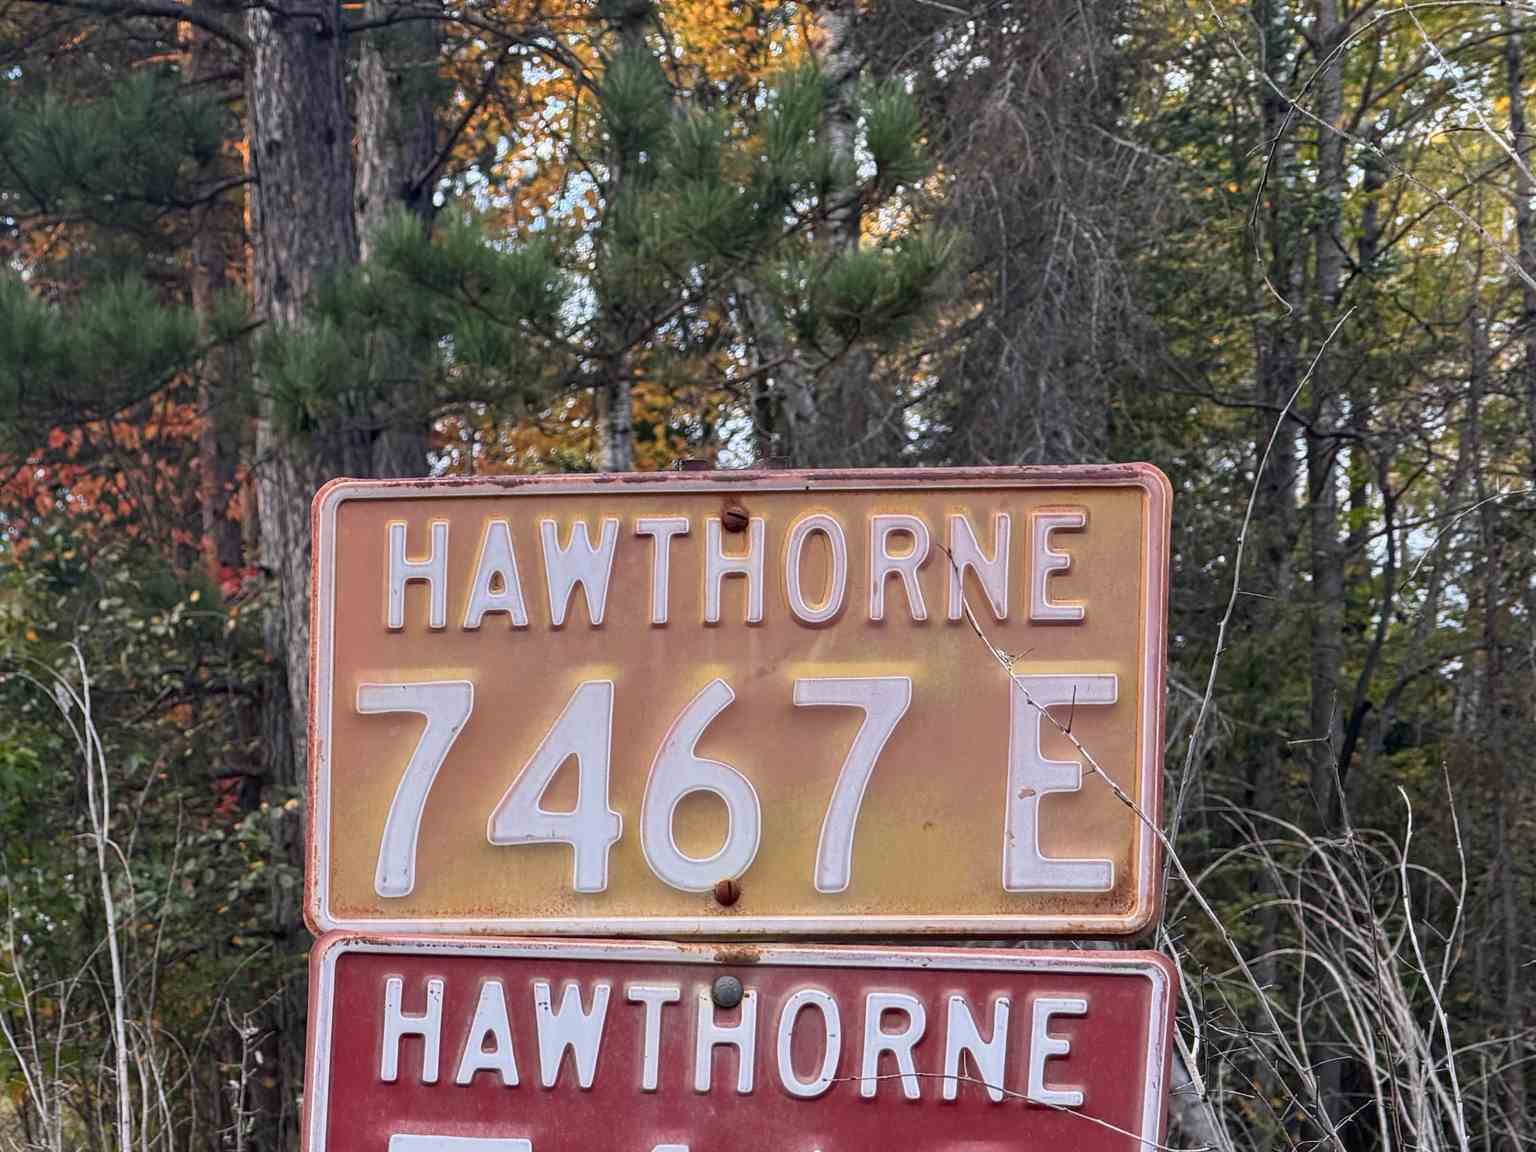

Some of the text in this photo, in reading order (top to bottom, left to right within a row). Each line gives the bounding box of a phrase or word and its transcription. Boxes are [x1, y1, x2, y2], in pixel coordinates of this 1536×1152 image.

[386, 509, 1087, 631] HAWTHORNE
[355, 673, 1119, 898] 7467 E
[380, 977, 1089, 1108] HAWTHORNE
